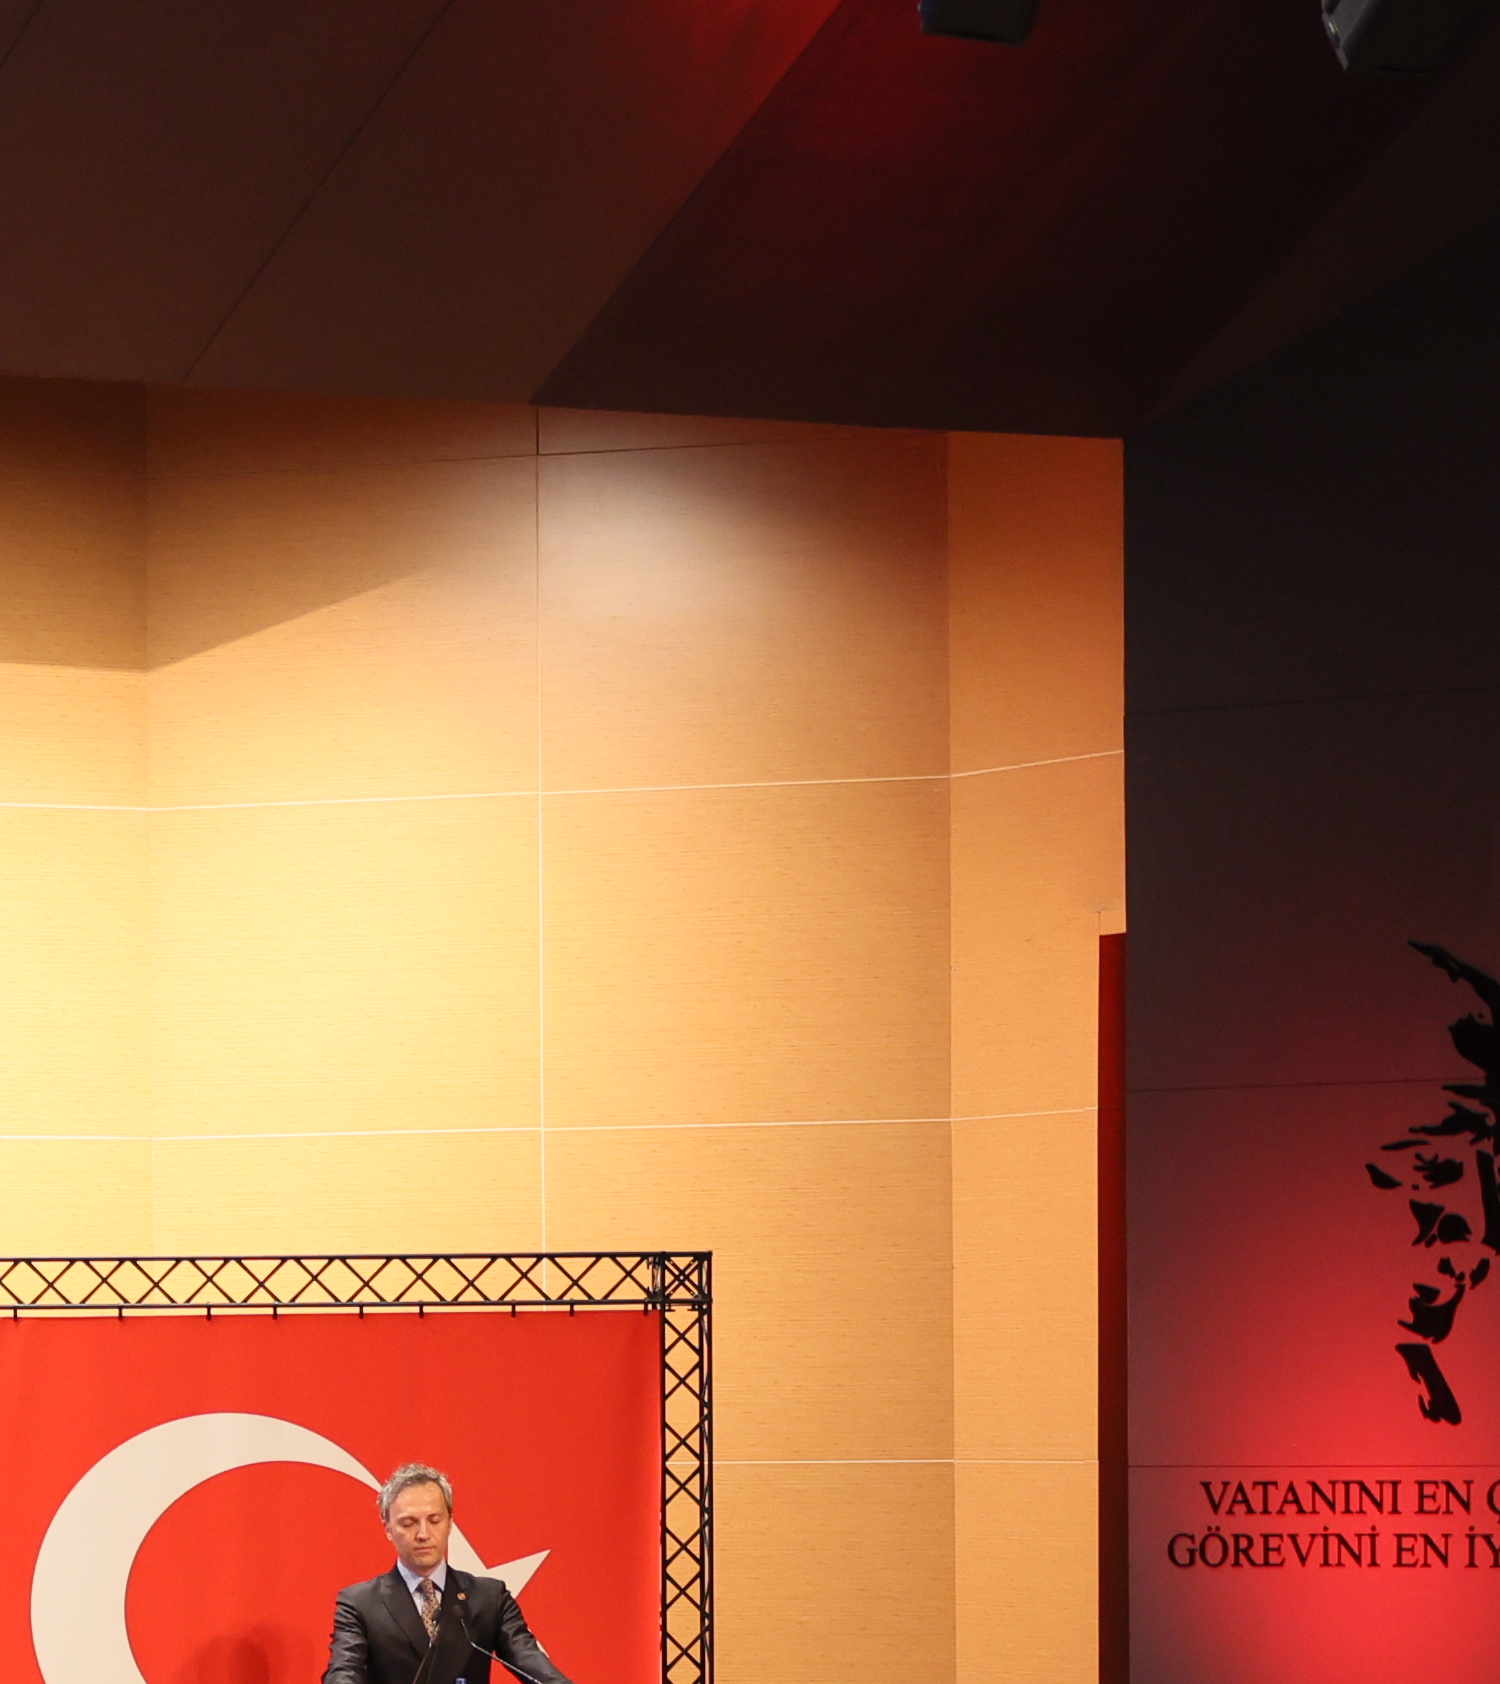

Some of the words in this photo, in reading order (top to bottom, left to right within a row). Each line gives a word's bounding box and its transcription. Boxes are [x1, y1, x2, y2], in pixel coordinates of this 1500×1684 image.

[1200, 1479, 1402, 1516] VATANINI
[1414, 1479, 1473, 1516] EN
[1167, 1524, 1380, 1569] GÖREVİNİ
[1393, 1533, 1452, 1569] EN
